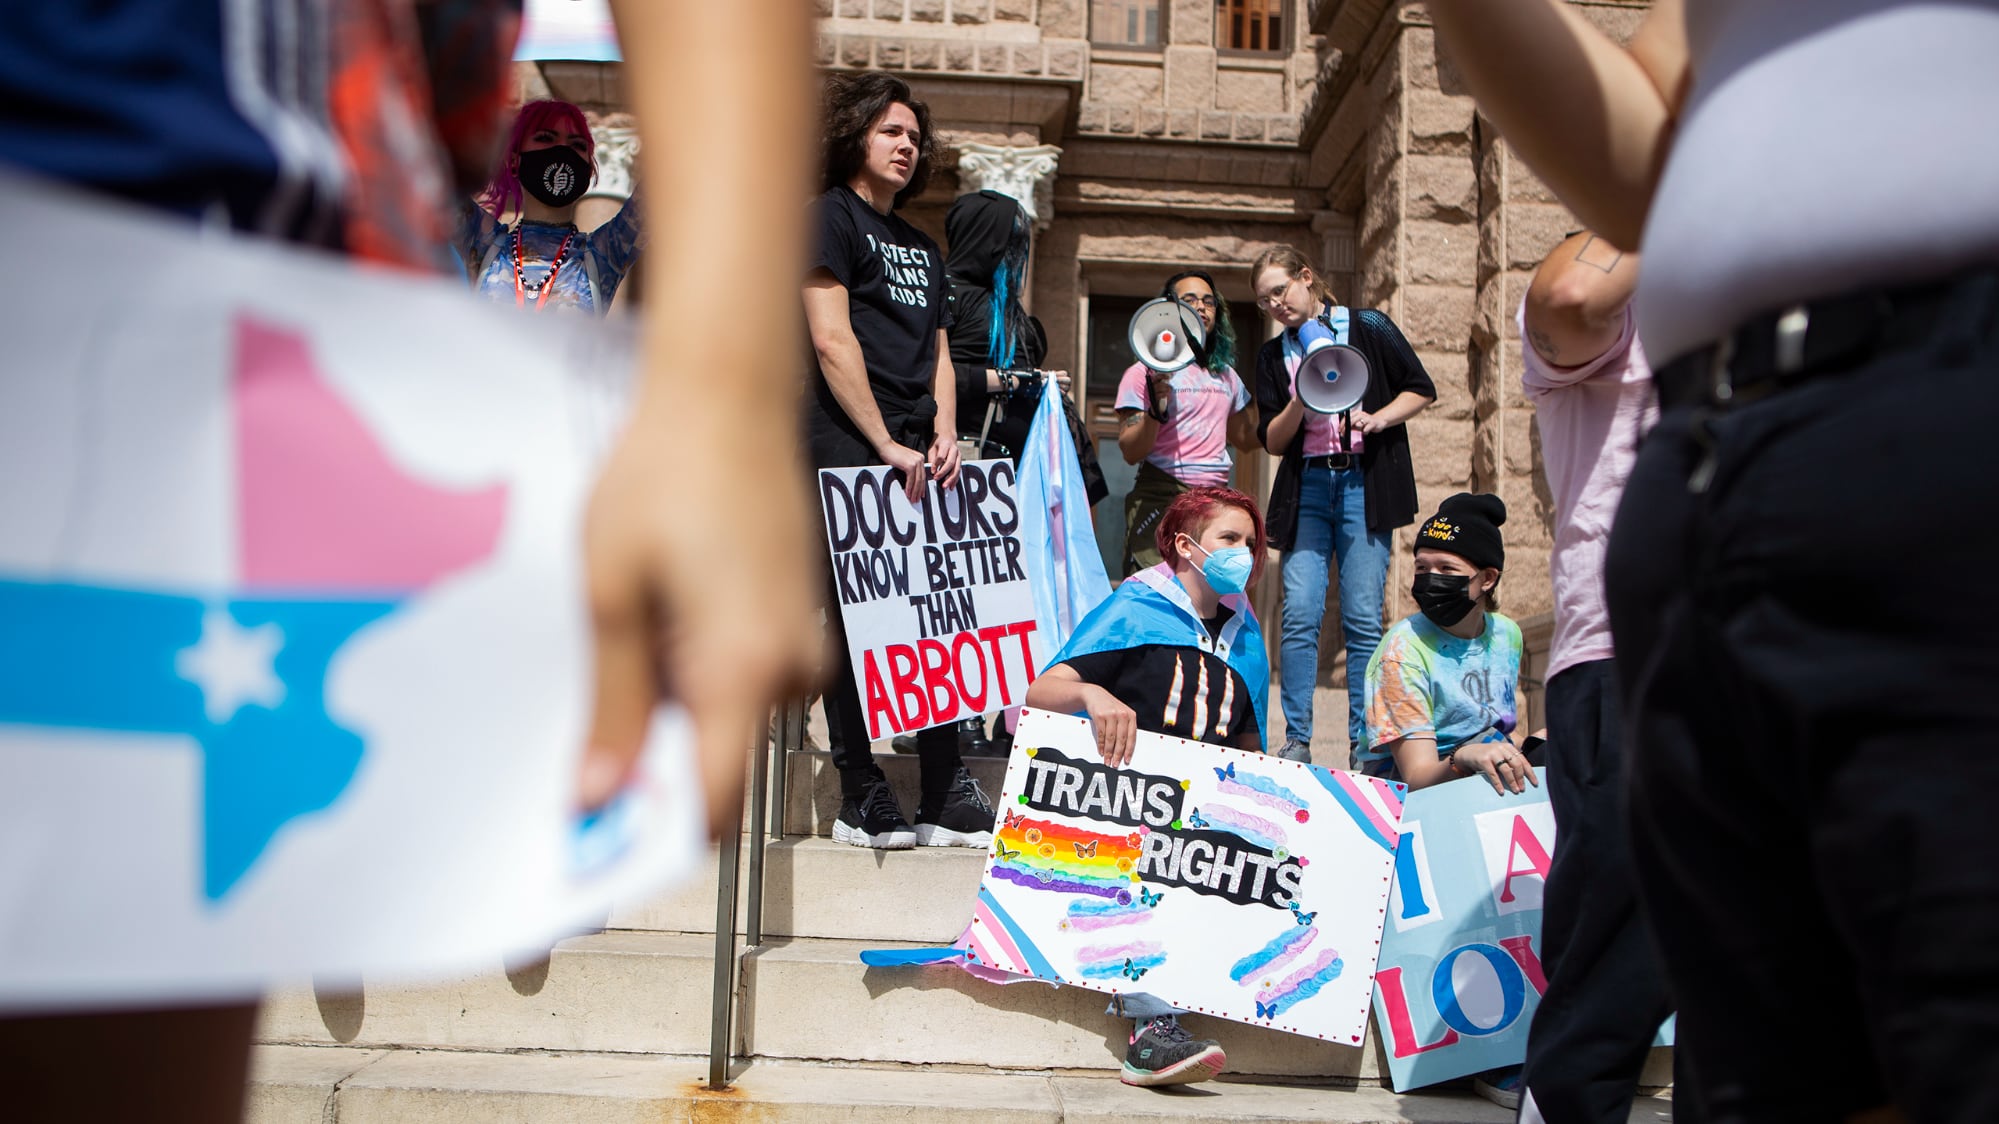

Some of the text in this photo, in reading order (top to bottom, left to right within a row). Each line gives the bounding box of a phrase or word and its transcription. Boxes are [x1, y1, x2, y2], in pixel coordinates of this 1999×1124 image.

[866, 233, 931, 268] POTECT
[887, 283, 928, 308] KIDS
[820, 460, 1019, 553] DOCTORS
[834, 536, 1027, 605] KNOW BETTER
[909, 587, 978, 639] THAN
[863, 619, 1037, 740] ABBOTT
[1028, 757, 1177, 828] TRANS
[1138, 829, 1304, 911] RIGHTS
[1394, 831, 1431, 920] I
